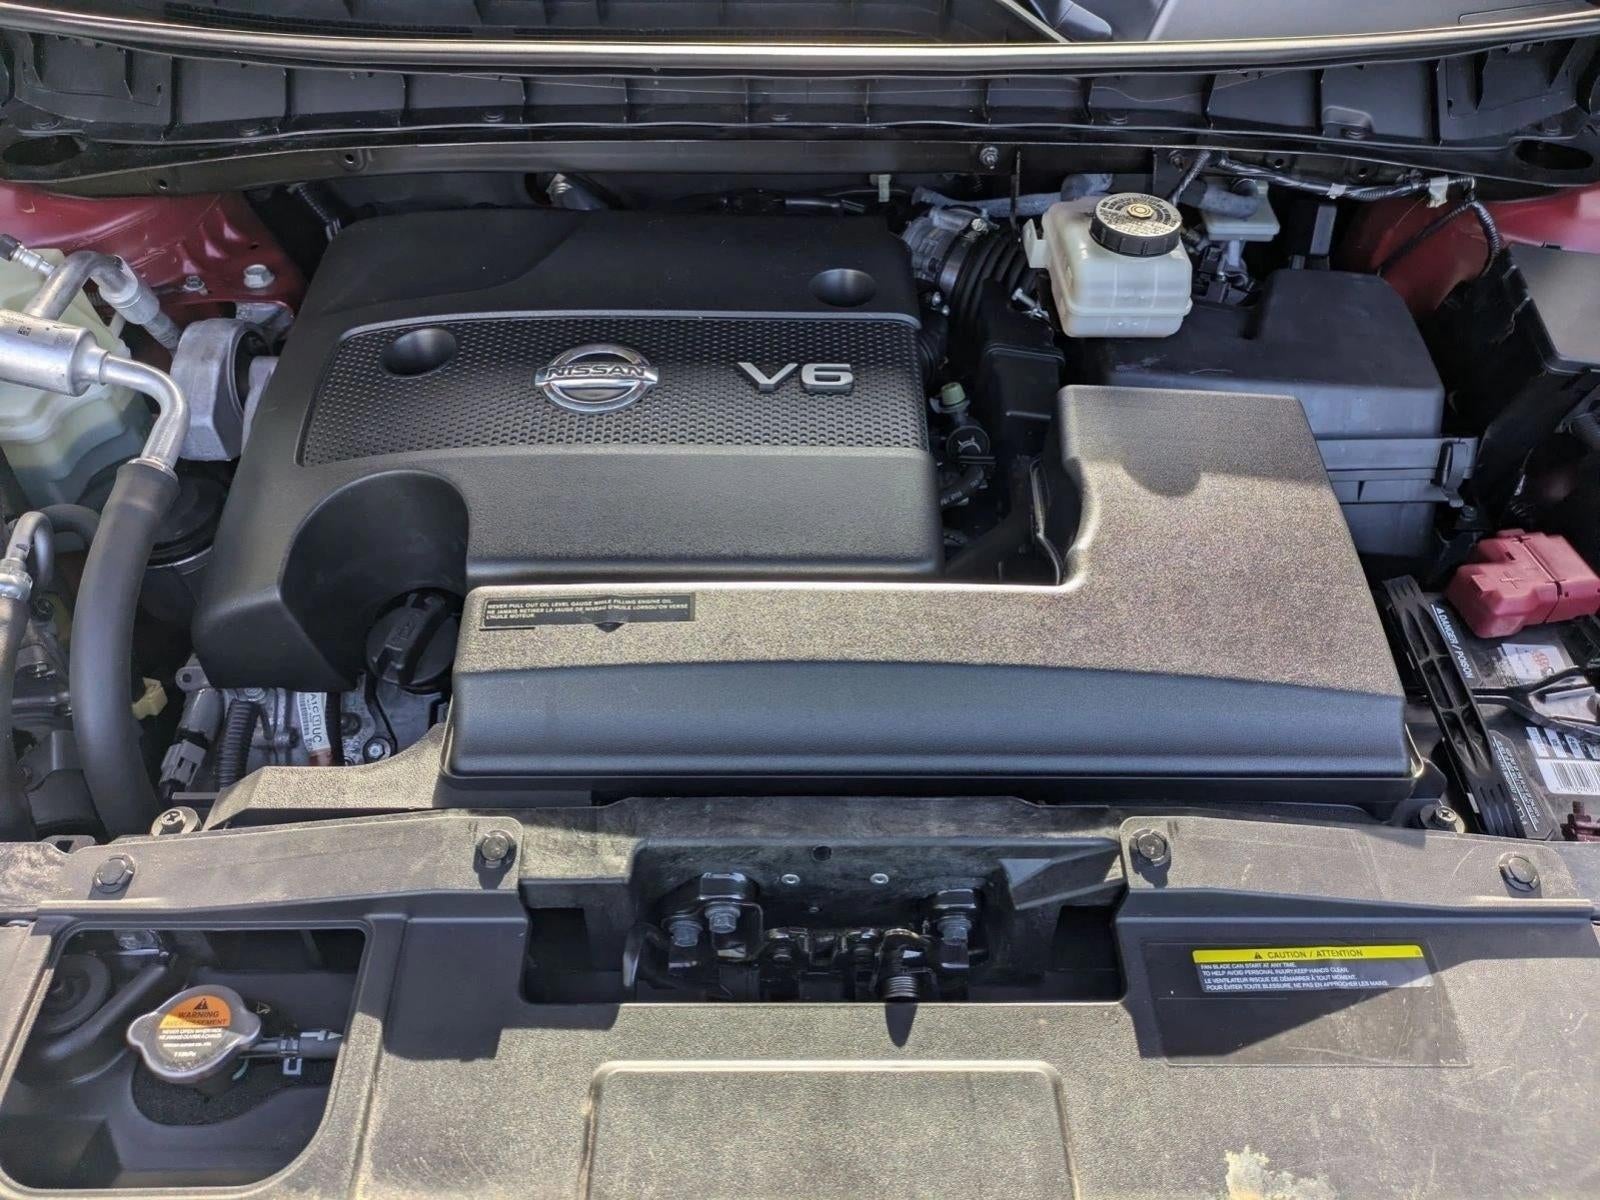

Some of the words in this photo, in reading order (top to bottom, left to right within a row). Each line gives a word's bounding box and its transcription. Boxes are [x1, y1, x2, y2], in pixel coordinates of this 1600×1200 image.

[548, 364, 646, 378] NISSAN
[737, 361, 855, 393] V6
[1439, 614, 1459, 644] DANGER
[1455, 649, 1474, 679] POISON
[1267, 950, 1307, 960] CAUTION
[1316, 947, 1364, 958] ATTENTION
[1324, 980, 1358, 988] APPROCHER
[1358, 979, 1369, 987] LES
